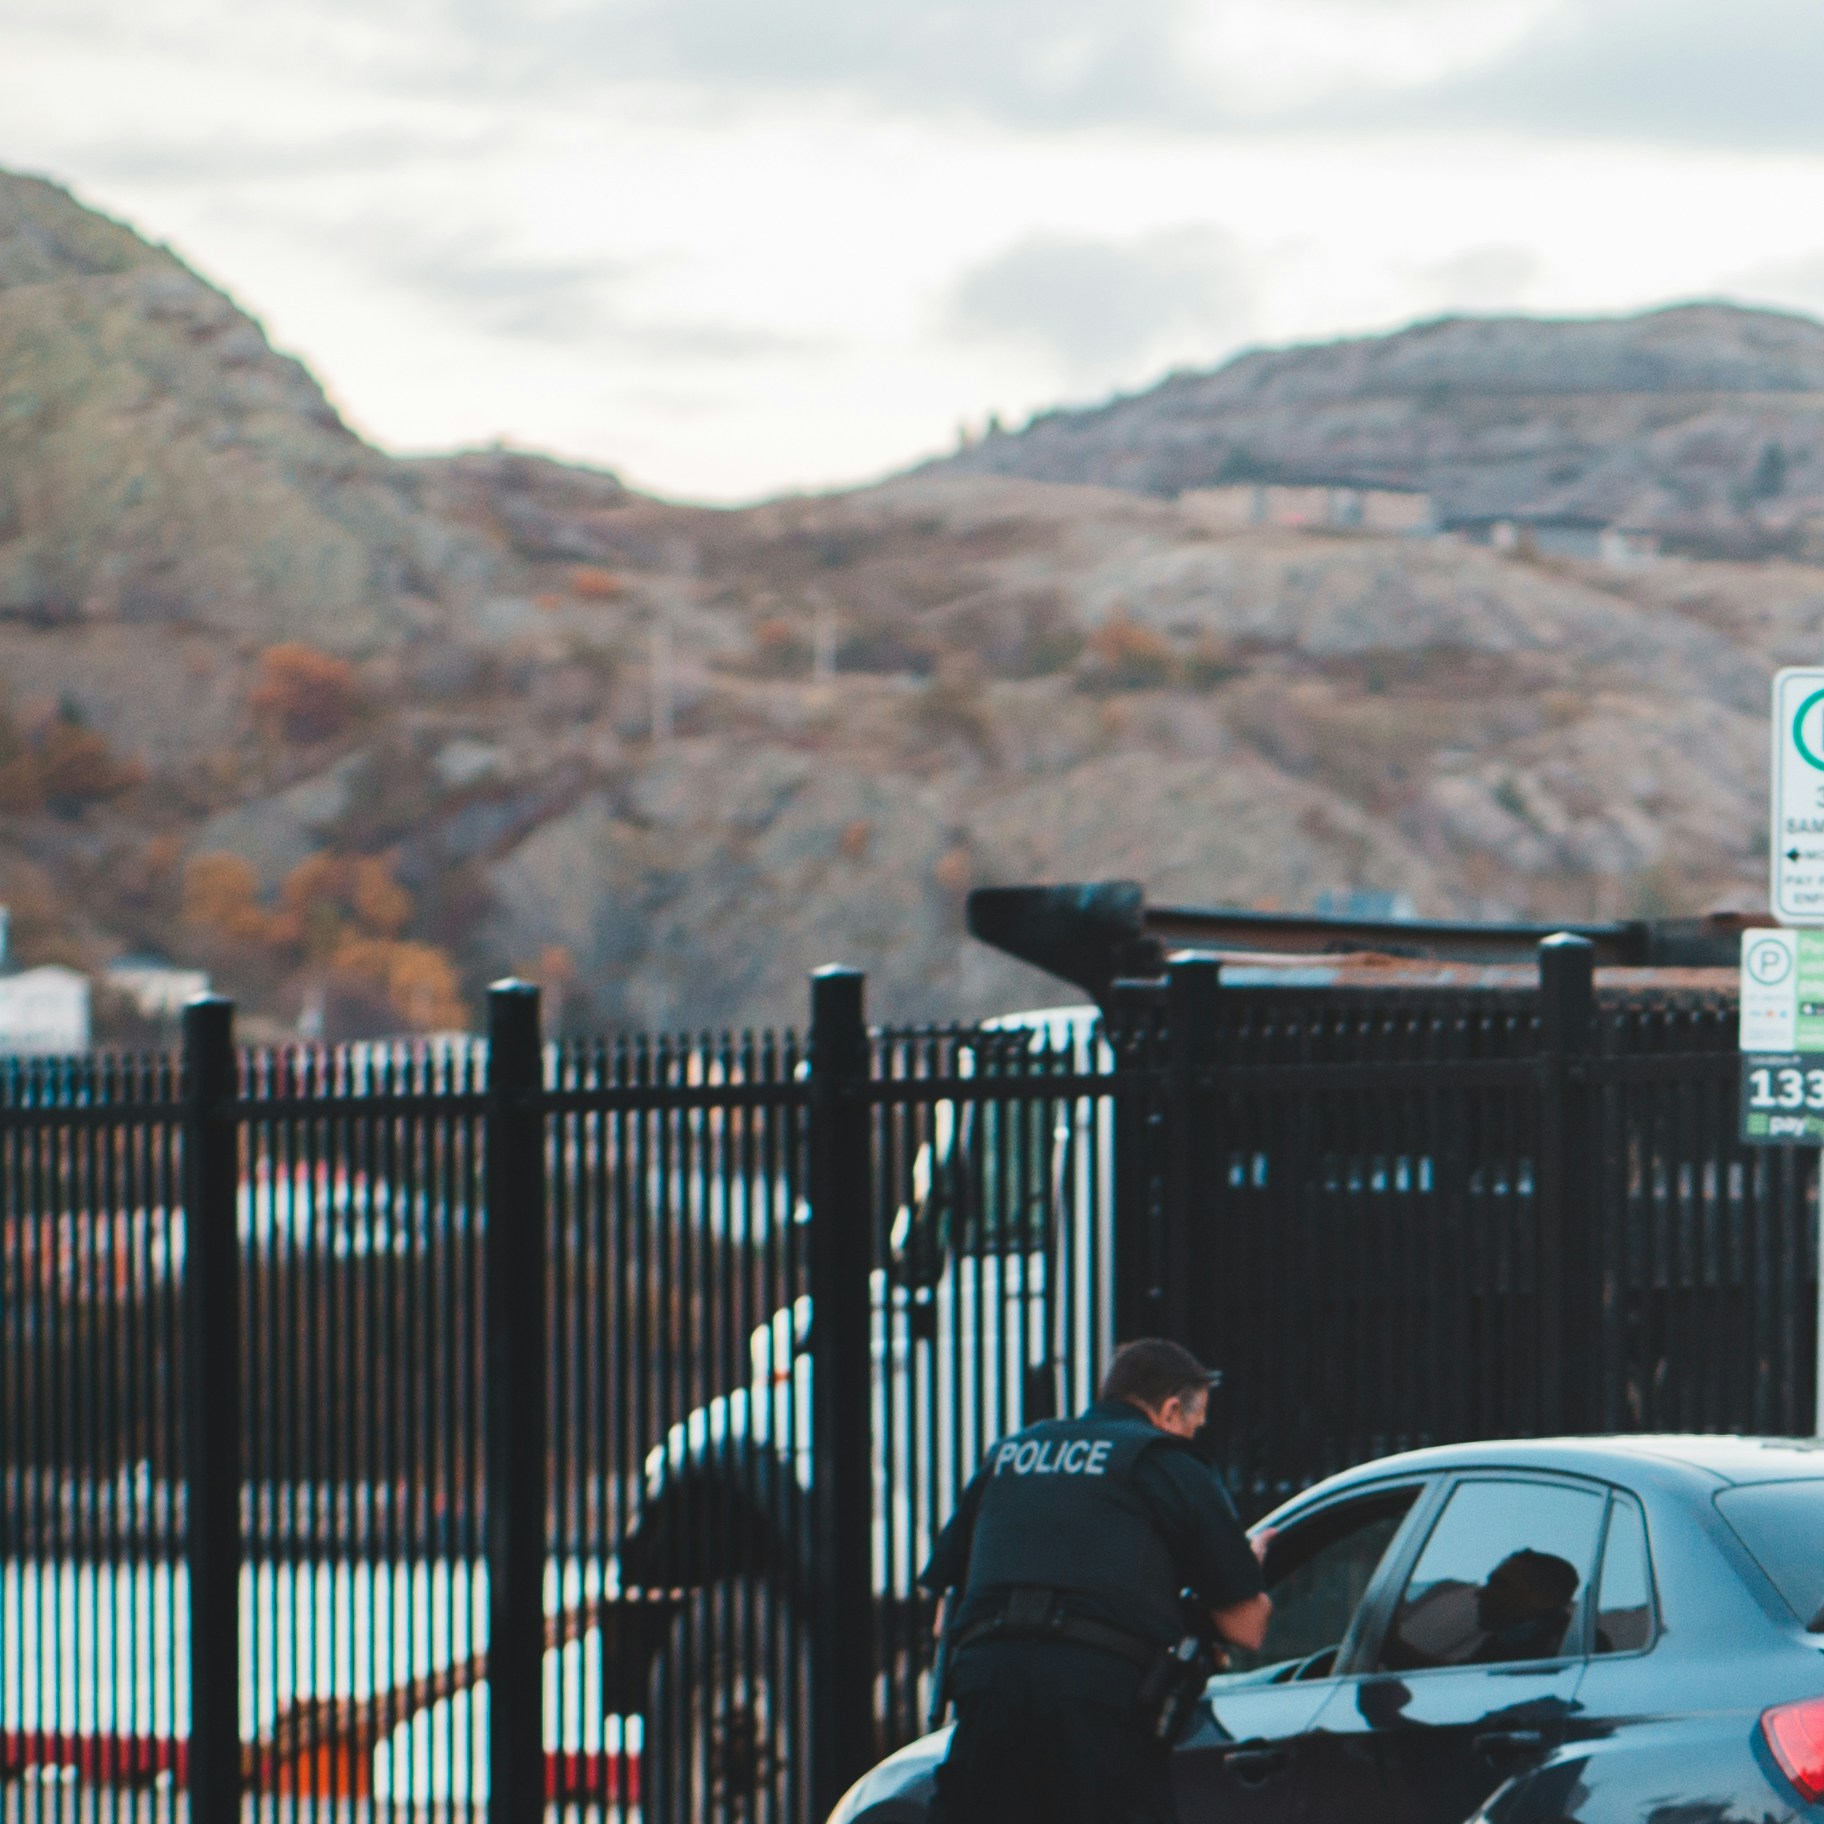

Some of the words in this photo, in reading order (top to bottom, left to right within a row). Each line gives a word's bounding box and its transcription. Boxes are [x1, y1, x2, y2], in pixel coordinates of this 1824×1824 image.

[1785, 875, 1812, 886] PAY
[1761, 950, 1780, 975] P
[994, 1439, 1112, 1477] POLICE
